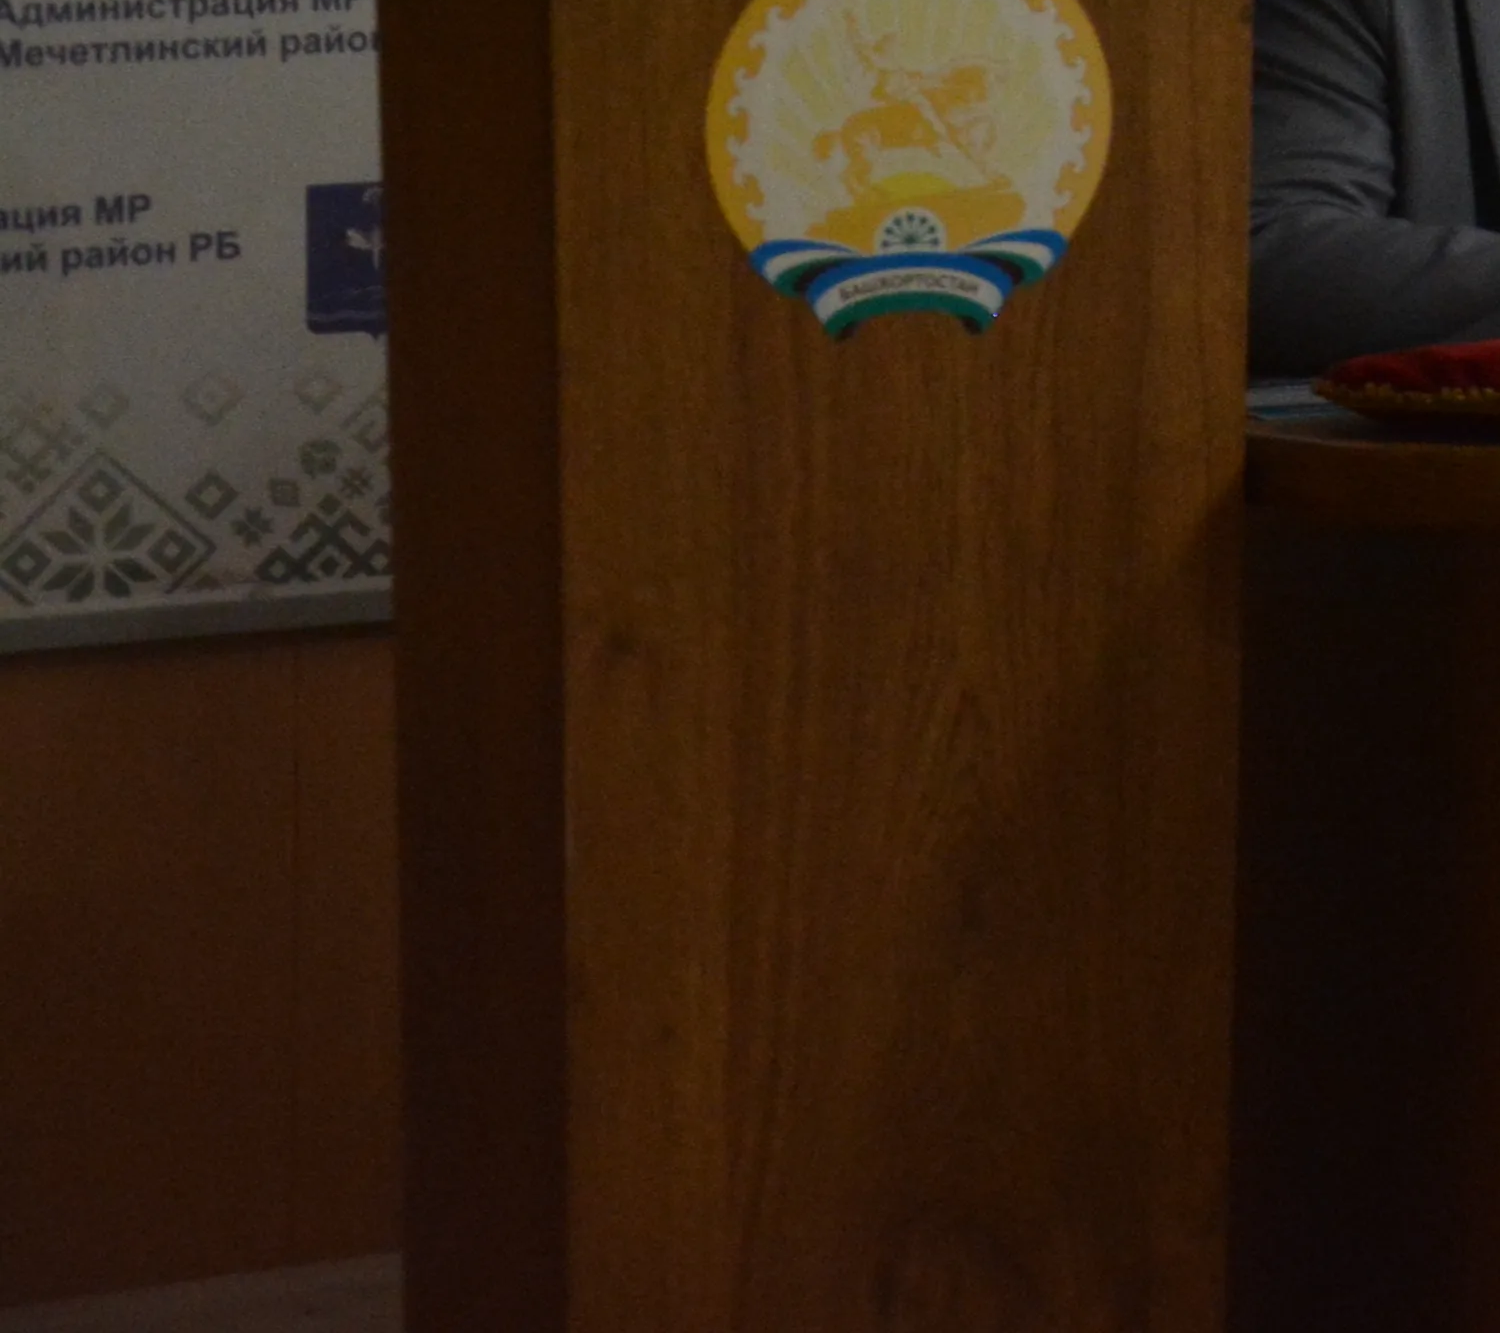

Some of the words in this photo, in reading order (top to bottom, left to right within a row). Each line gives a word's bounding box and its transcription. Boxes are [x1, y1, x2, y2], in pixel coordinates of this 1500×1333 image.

[95, 194, 152, 225] МР
[60, 238, 175, 276] район
[189, 231, 241, 262] РБ
